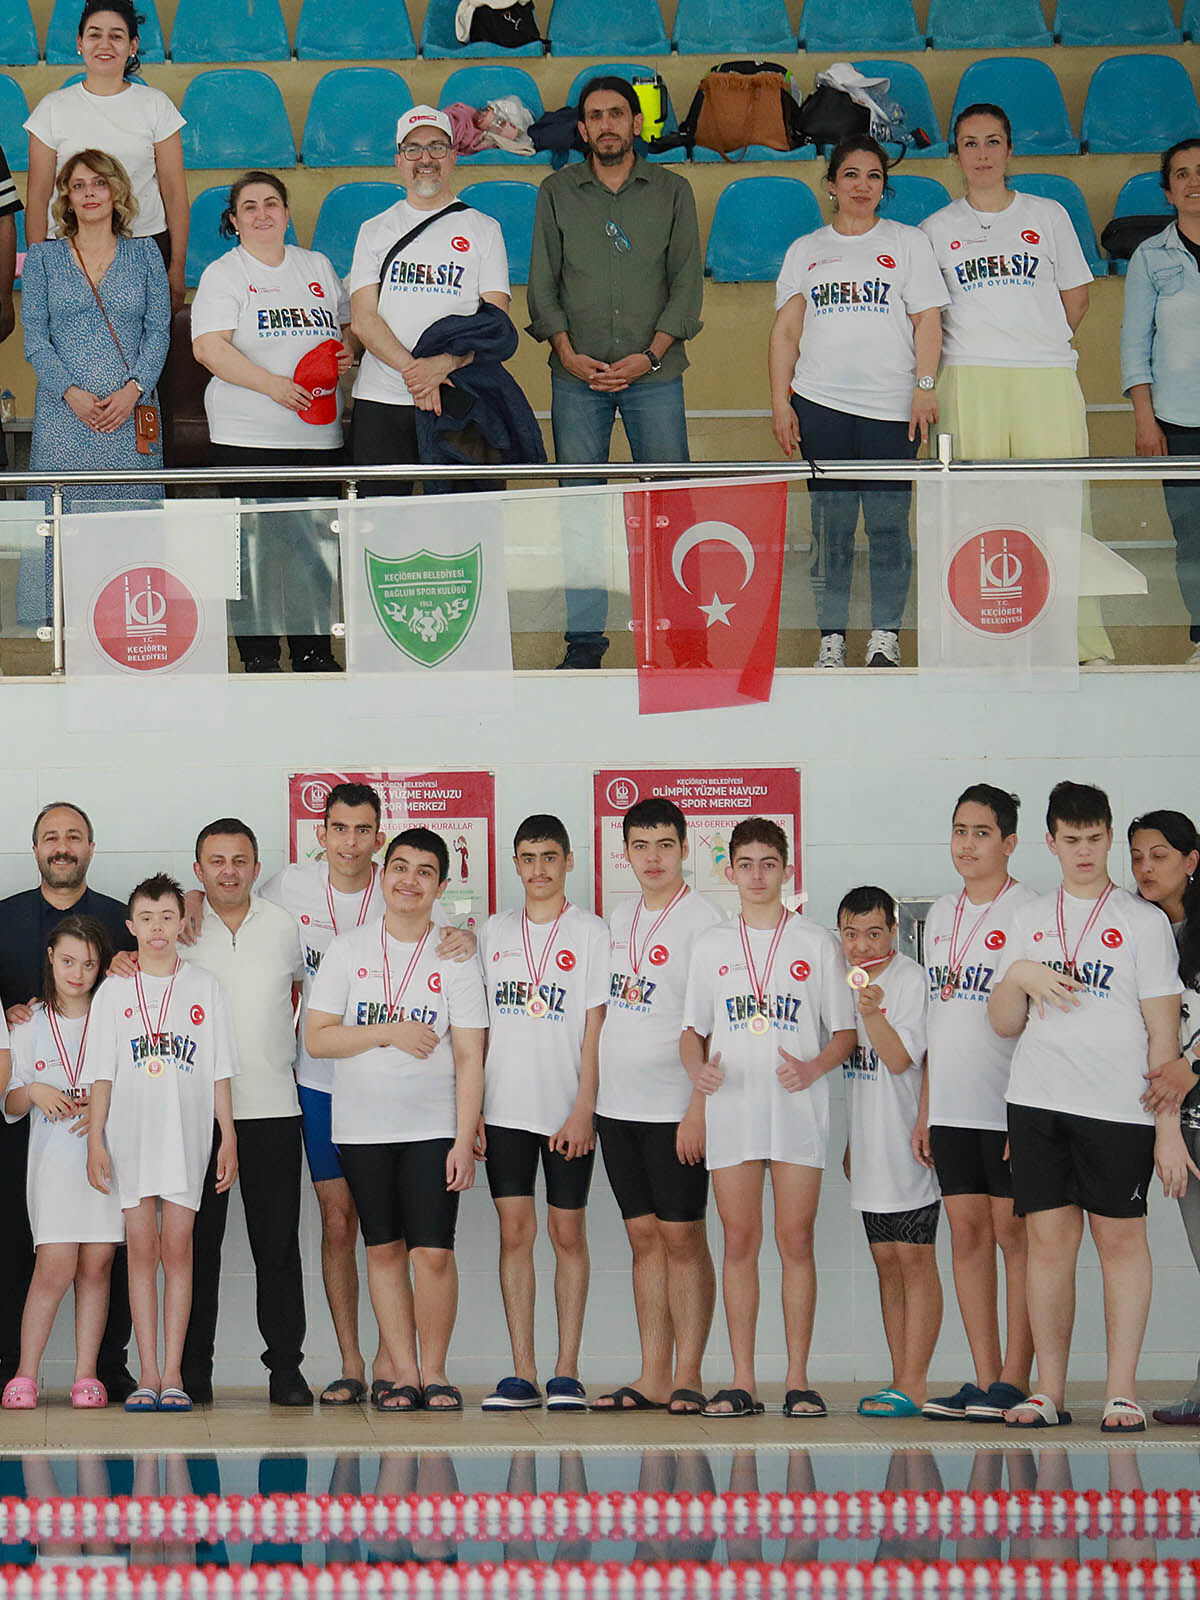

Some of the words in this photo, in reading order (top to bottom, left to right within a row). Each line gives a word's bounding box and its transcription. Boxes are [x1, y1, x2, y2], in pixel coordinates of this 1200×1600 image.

[257, 306, 338, 331] ENGELSİZ
[424, 788, 463, 800] HAVUZU
[652, 786, 693, 797] OLİMPİK
[694, 785, 727, 796] YÜZME
[729, 785, 768, 796] HAVUZU
[406, 799, 446, 812] MERKEZİ
[681, 799, 707, 809] SPOR
[709, 797, 752, 808] MERKEZİ
[432, 822, 473, 831] KURALLAR
